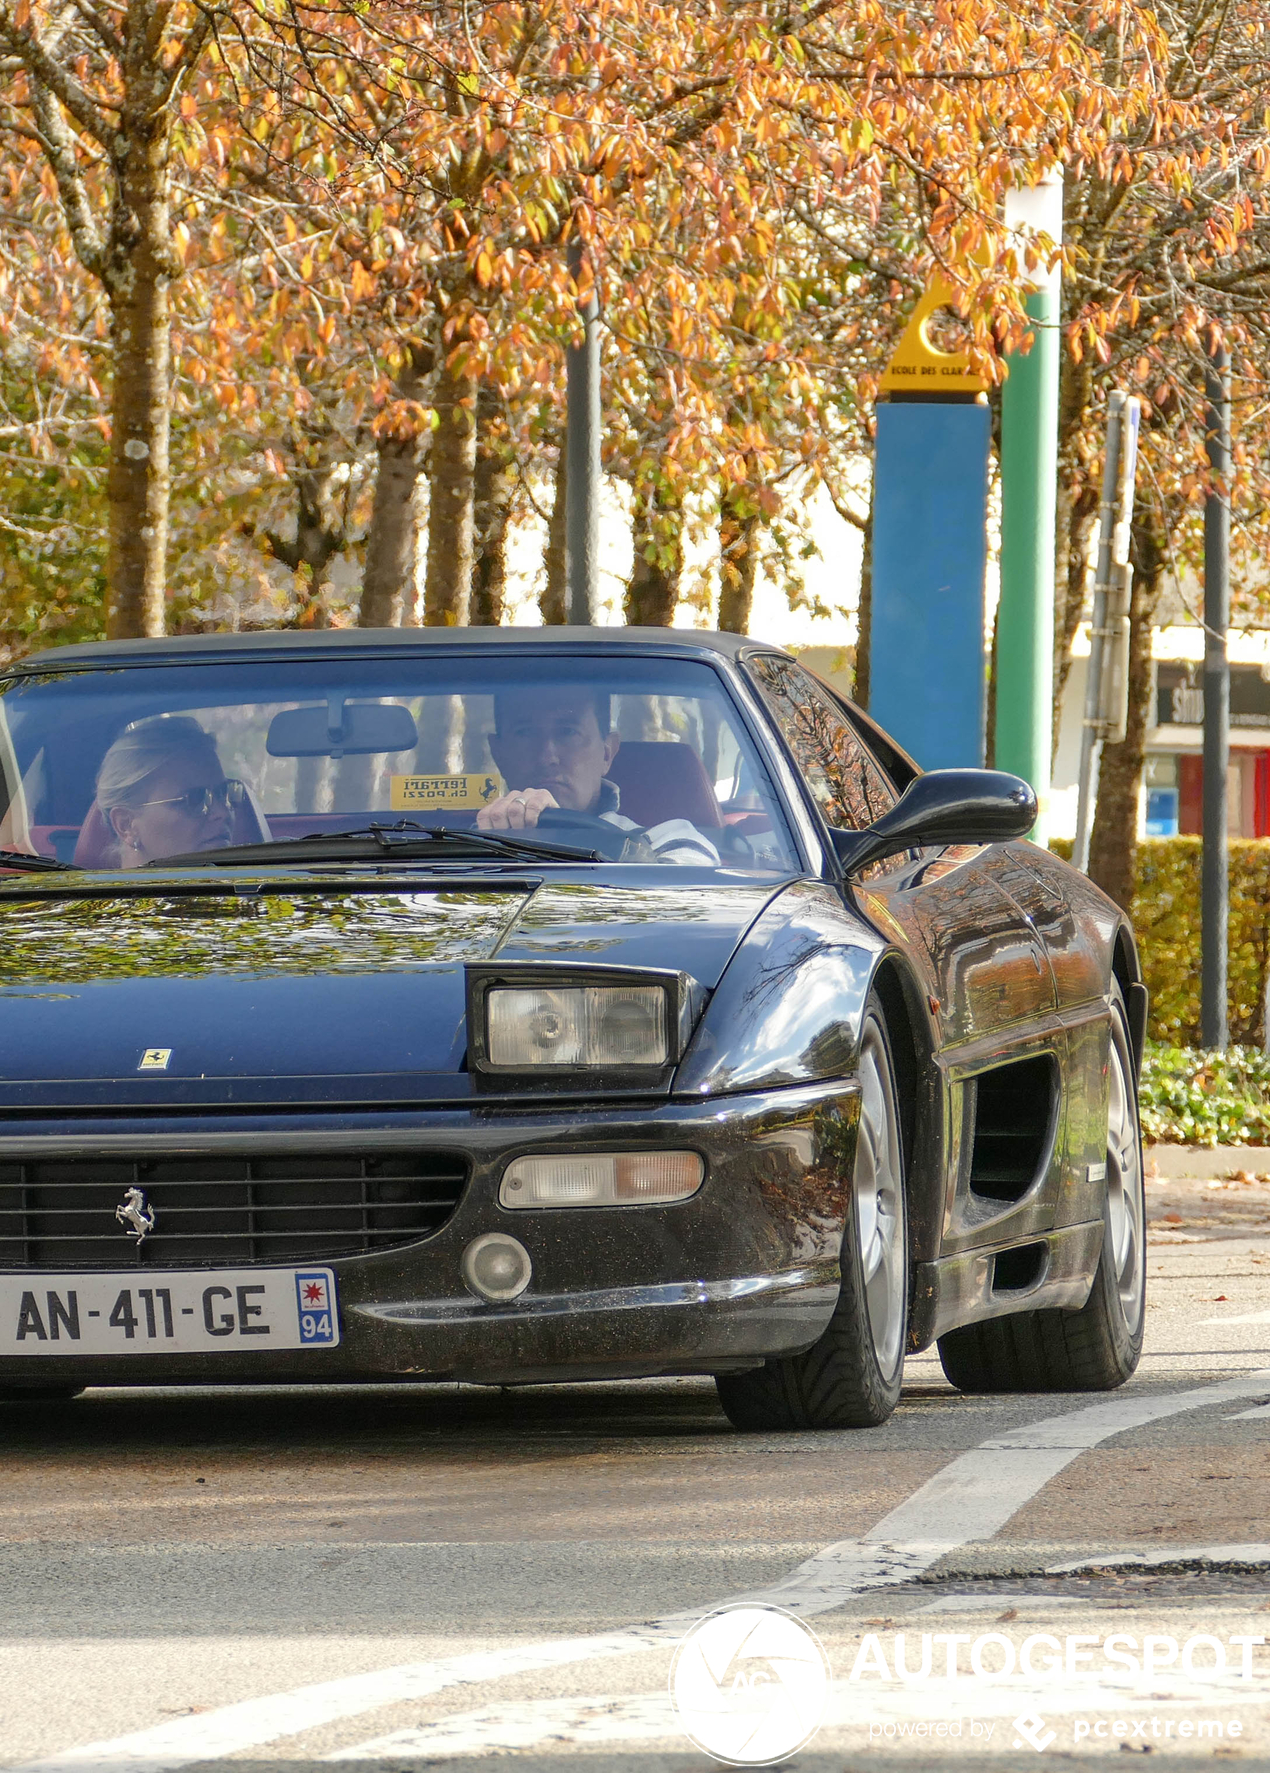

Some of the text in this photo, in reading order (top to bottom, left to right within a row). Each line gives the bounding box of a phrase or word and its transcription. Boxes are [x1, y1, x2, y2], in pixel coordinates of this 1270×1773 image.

[891, 366, 917, 375] ECOLE
[921, 366, 936, 376] DES
[16, 1285, 271, 1341] AN-411-GE
[301, 1313, 332, 1339] 94
